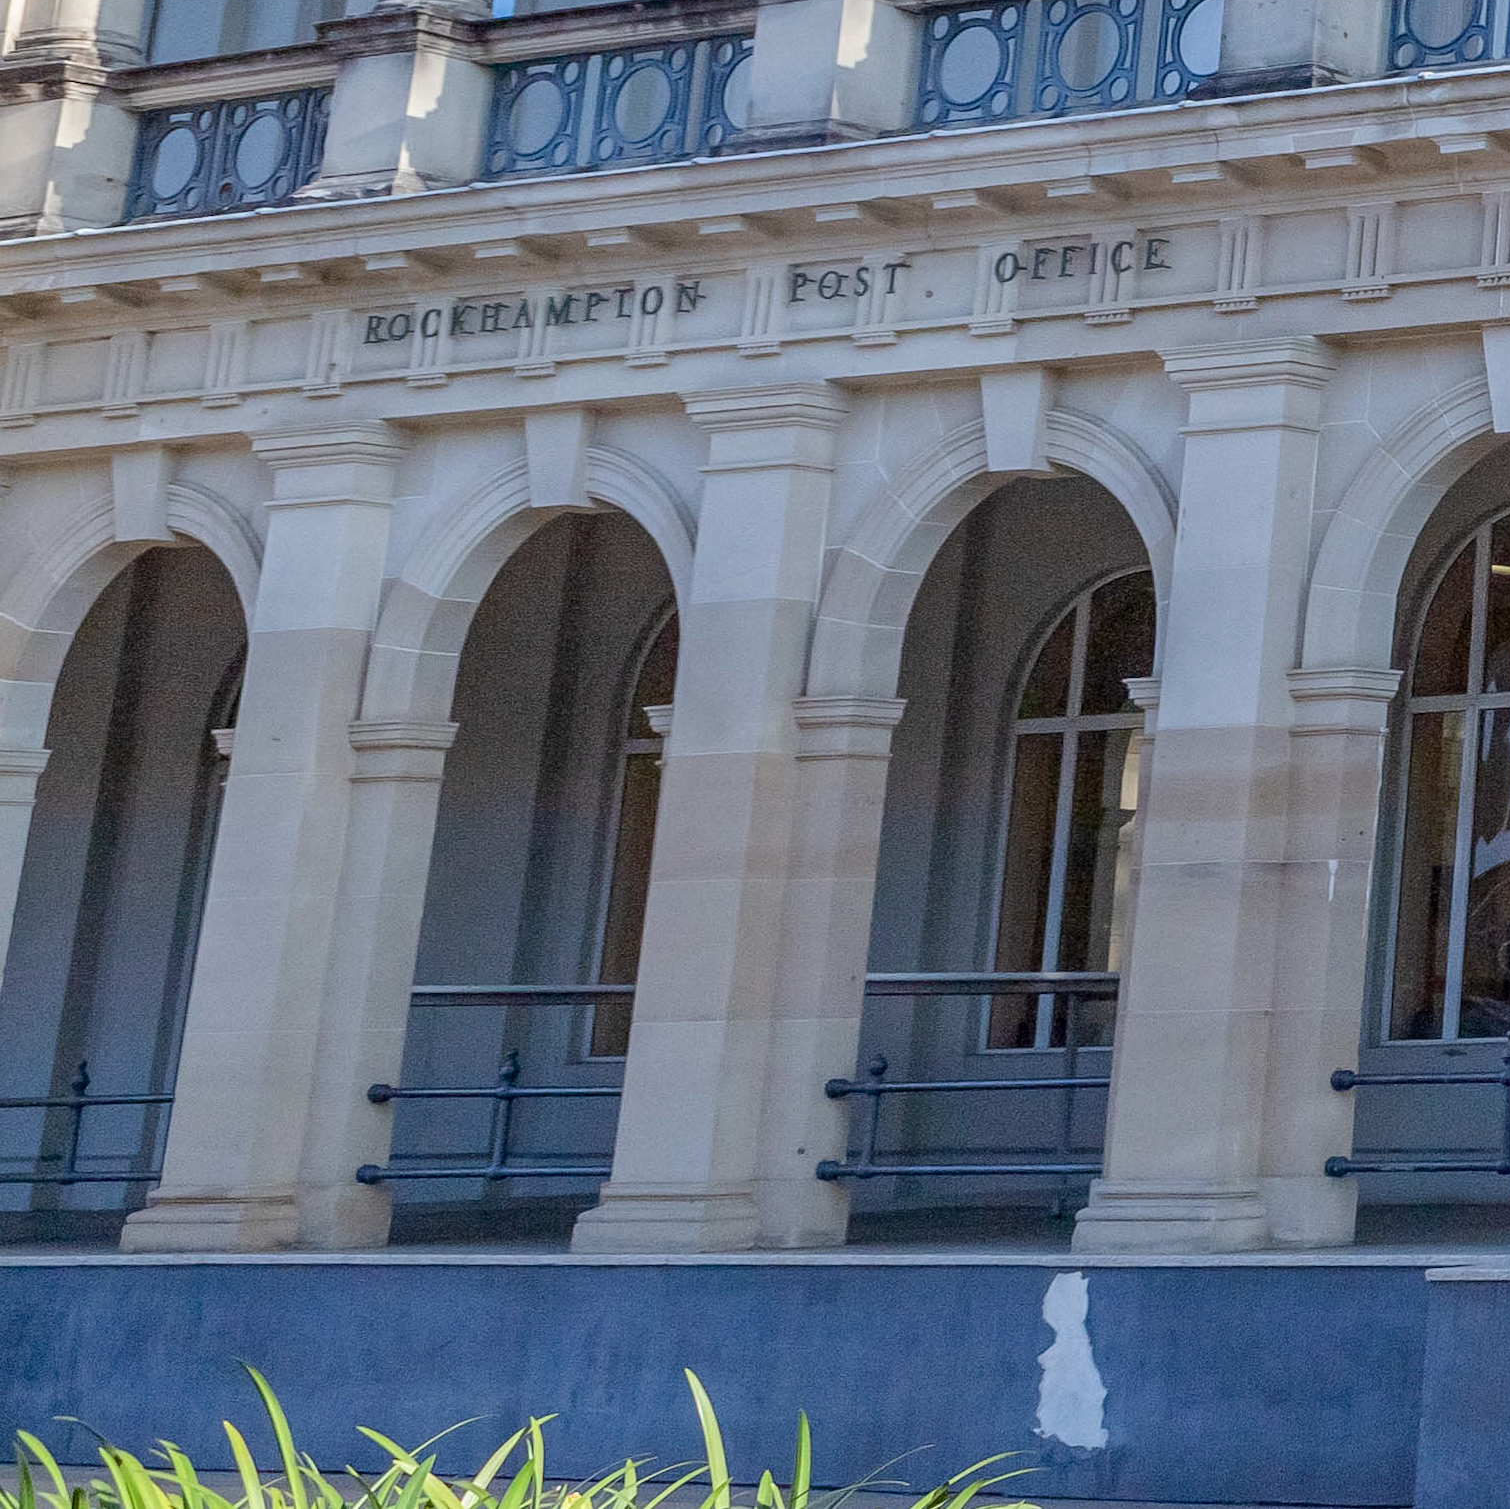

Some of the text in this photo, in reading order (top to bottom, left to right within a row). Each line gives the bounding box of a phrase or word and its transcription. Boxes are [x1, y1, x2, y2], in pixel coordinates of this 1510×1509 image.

[364, 238, 1171, 344] ROCKHAMPTON POST OFFICE
